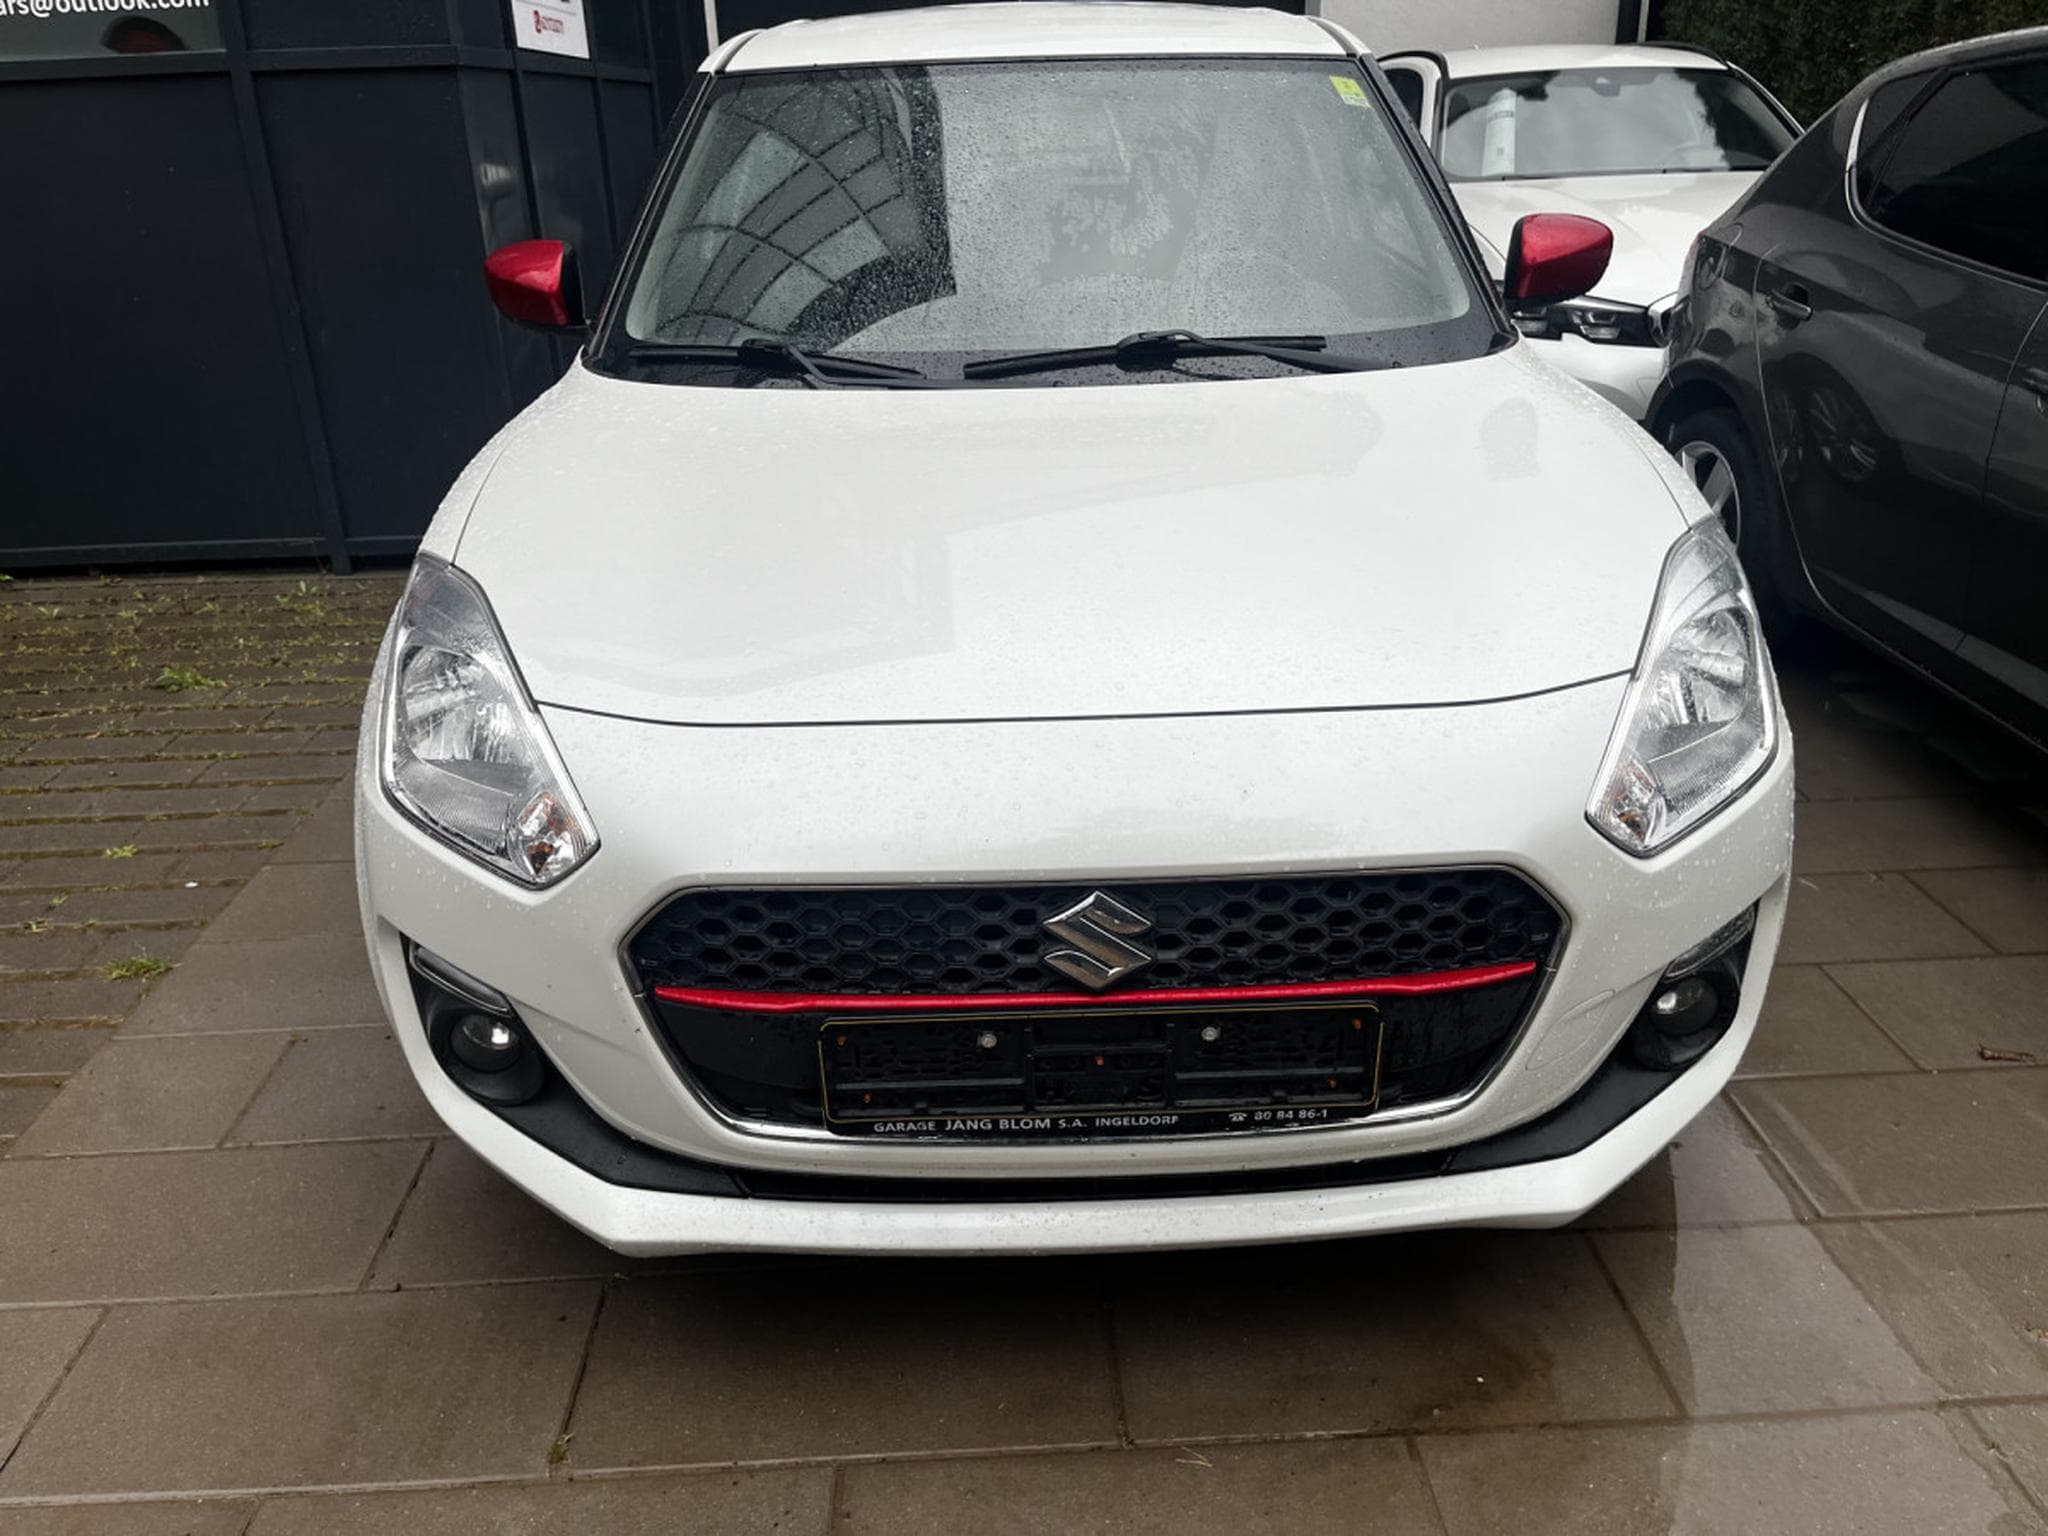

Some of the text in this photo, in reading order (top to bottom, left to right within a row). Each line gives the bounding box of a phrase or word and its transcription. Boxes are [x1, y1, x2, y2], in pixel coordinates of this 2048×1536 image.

[873, 1115, 1179, 1133] GARAGE JANG BLOM S.A. INGELDORF
